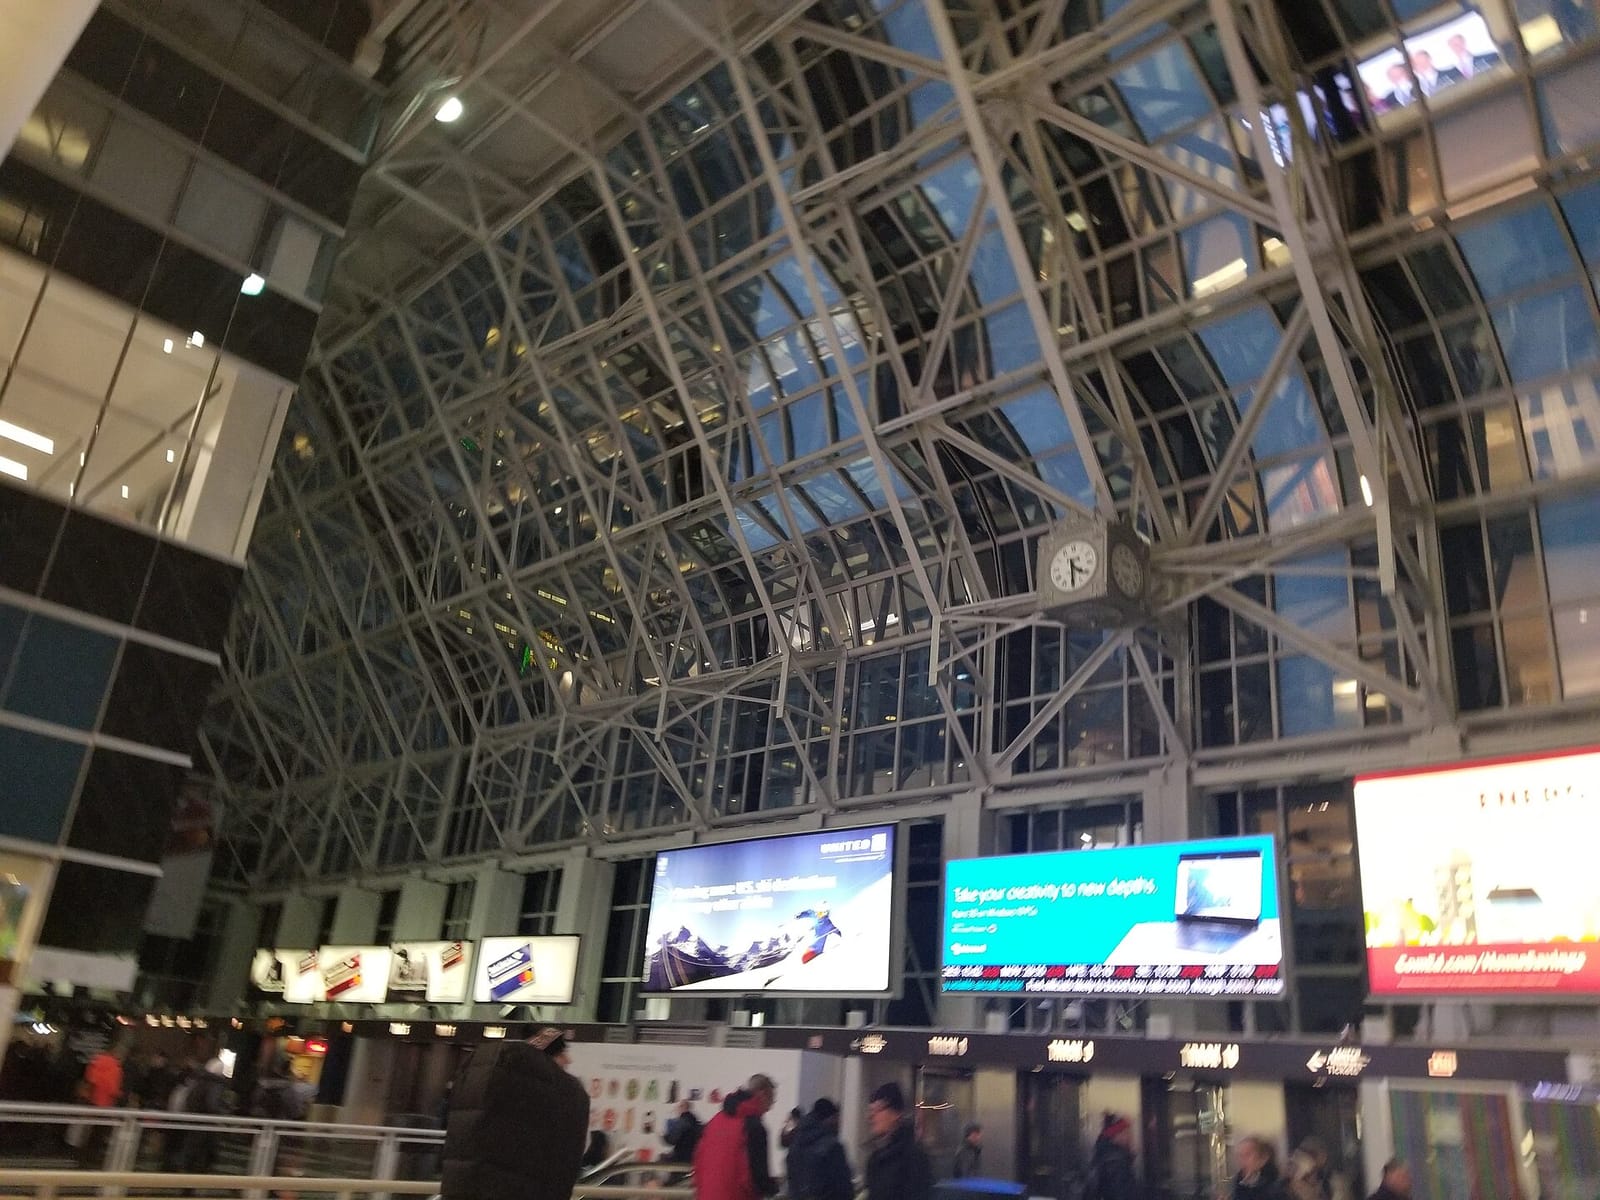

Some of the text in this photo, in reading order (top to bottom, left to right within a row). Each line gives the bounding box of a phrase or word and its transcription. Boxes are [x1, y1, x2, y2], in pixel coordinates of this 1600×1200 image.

[979, 887, 1006, 906] your
[1006, 882, 1060, 904] creativity
[1060, 882, 1077, 899] to
[1077, 881, 1106, 897] new
